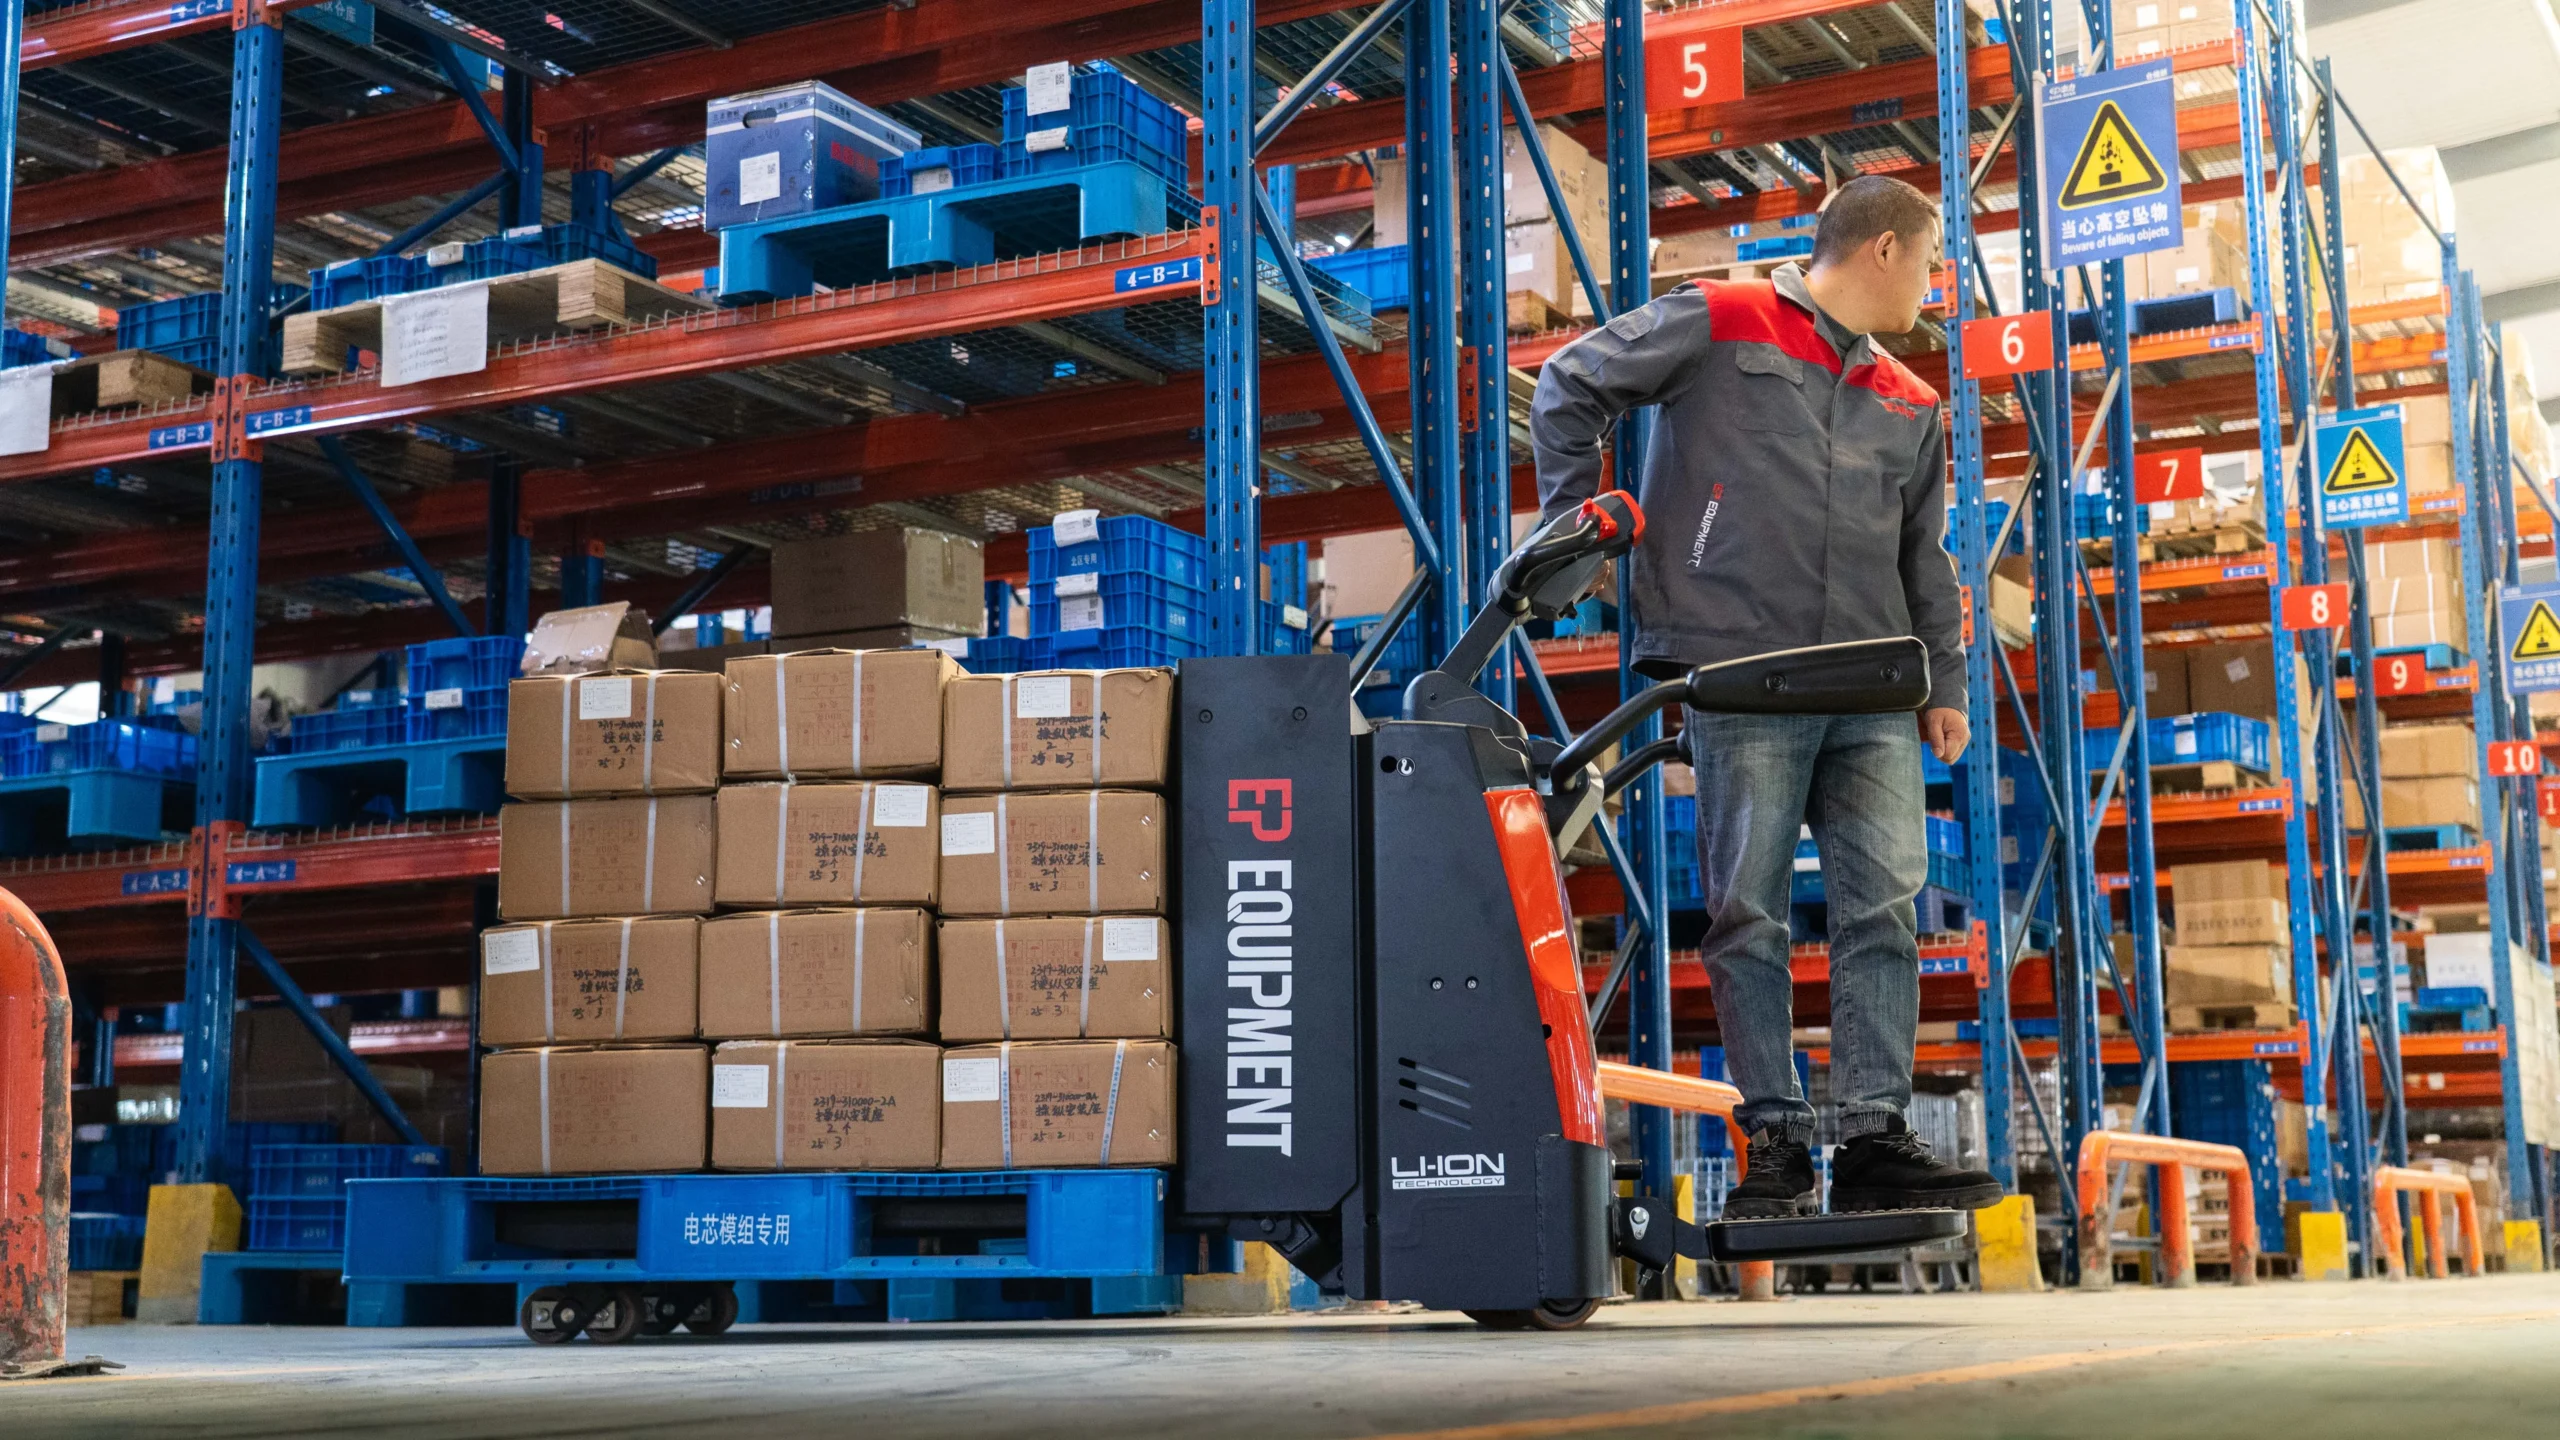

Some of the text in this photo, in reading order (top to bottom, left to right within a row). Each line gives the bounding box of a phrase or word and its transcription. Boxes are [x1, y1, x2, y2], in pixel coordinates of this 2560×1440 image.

[1683, 43, 1707, 98] 5
[2062, 202, 2168, 239] 当心高空坠物
[2062, 226, 2170, 255] Beware of falling objects
[1127, 261, 1189, 287] 4-B-1
[2002, 321, 2024, 365] 6
[254, 409, 303, 430] 4-B-2
[158, 422, 205, 446] 4-B-3
[2160, 459, 2180, 496] 7
[1686, 500, 1719, 567] EQUIPMENT
[1071, 552, 1097, 567] 北区专用
[2311, 590, 2330, 623] 8
[2390, 659, 2408, 690] 9
[2504, 745, 2535, 773] 10
[131, 872, 181, 892] 4-A-3
[235, 862, 288, 882] 4-A-2
[1227, 778, 1292, 1158] EP EQUIPMENT
[1054, 1004, 1063, 1016] 3
[834, 1137, 842, 1150] 3
[1391, 1153, 1504, 1178] LI-ION
[1394, 1177, 1503, 1188] TECHNOLOGY
[684, 1212, 790, 1246] 电芯模组专用
